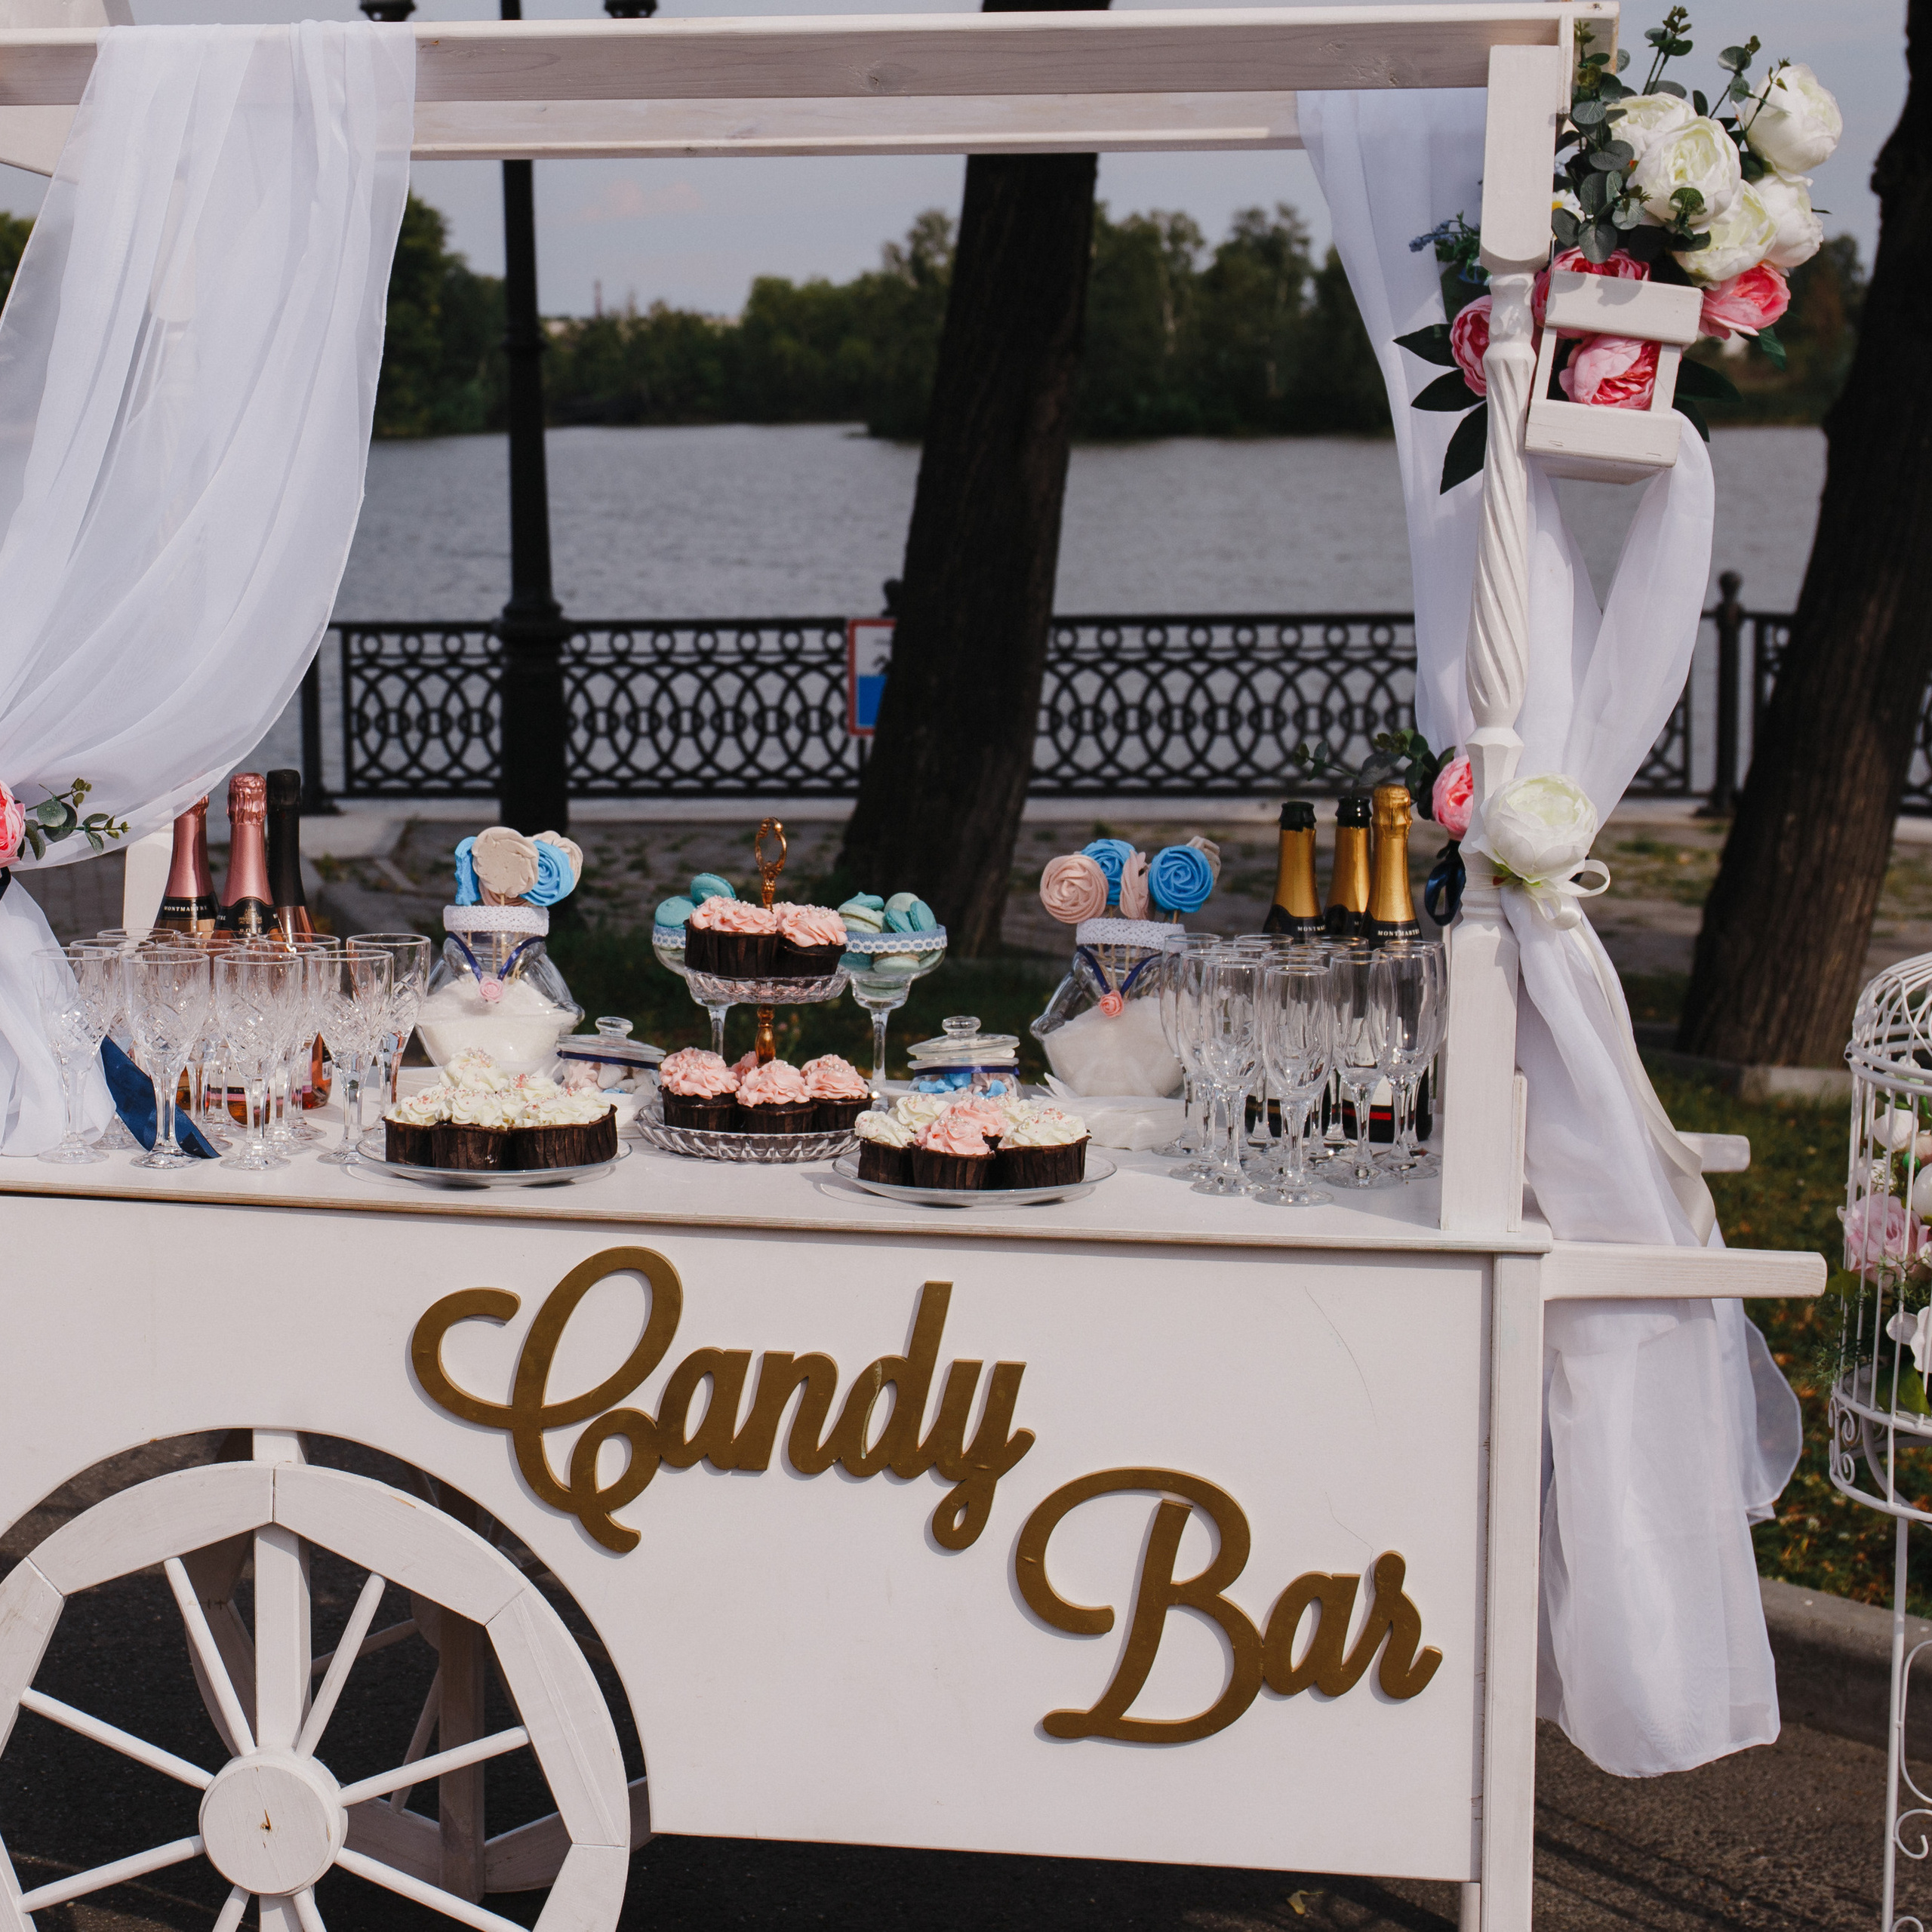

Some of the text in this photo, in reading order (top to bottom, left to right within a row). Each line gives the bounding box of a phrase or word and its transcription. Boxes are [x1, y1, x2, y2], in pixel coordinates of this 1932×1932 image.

[238, 926, 263, 935] ROÉ
[411, 1245, 1035, 1552] Candy
[1015, 1466, 1443, 1743] Bar
